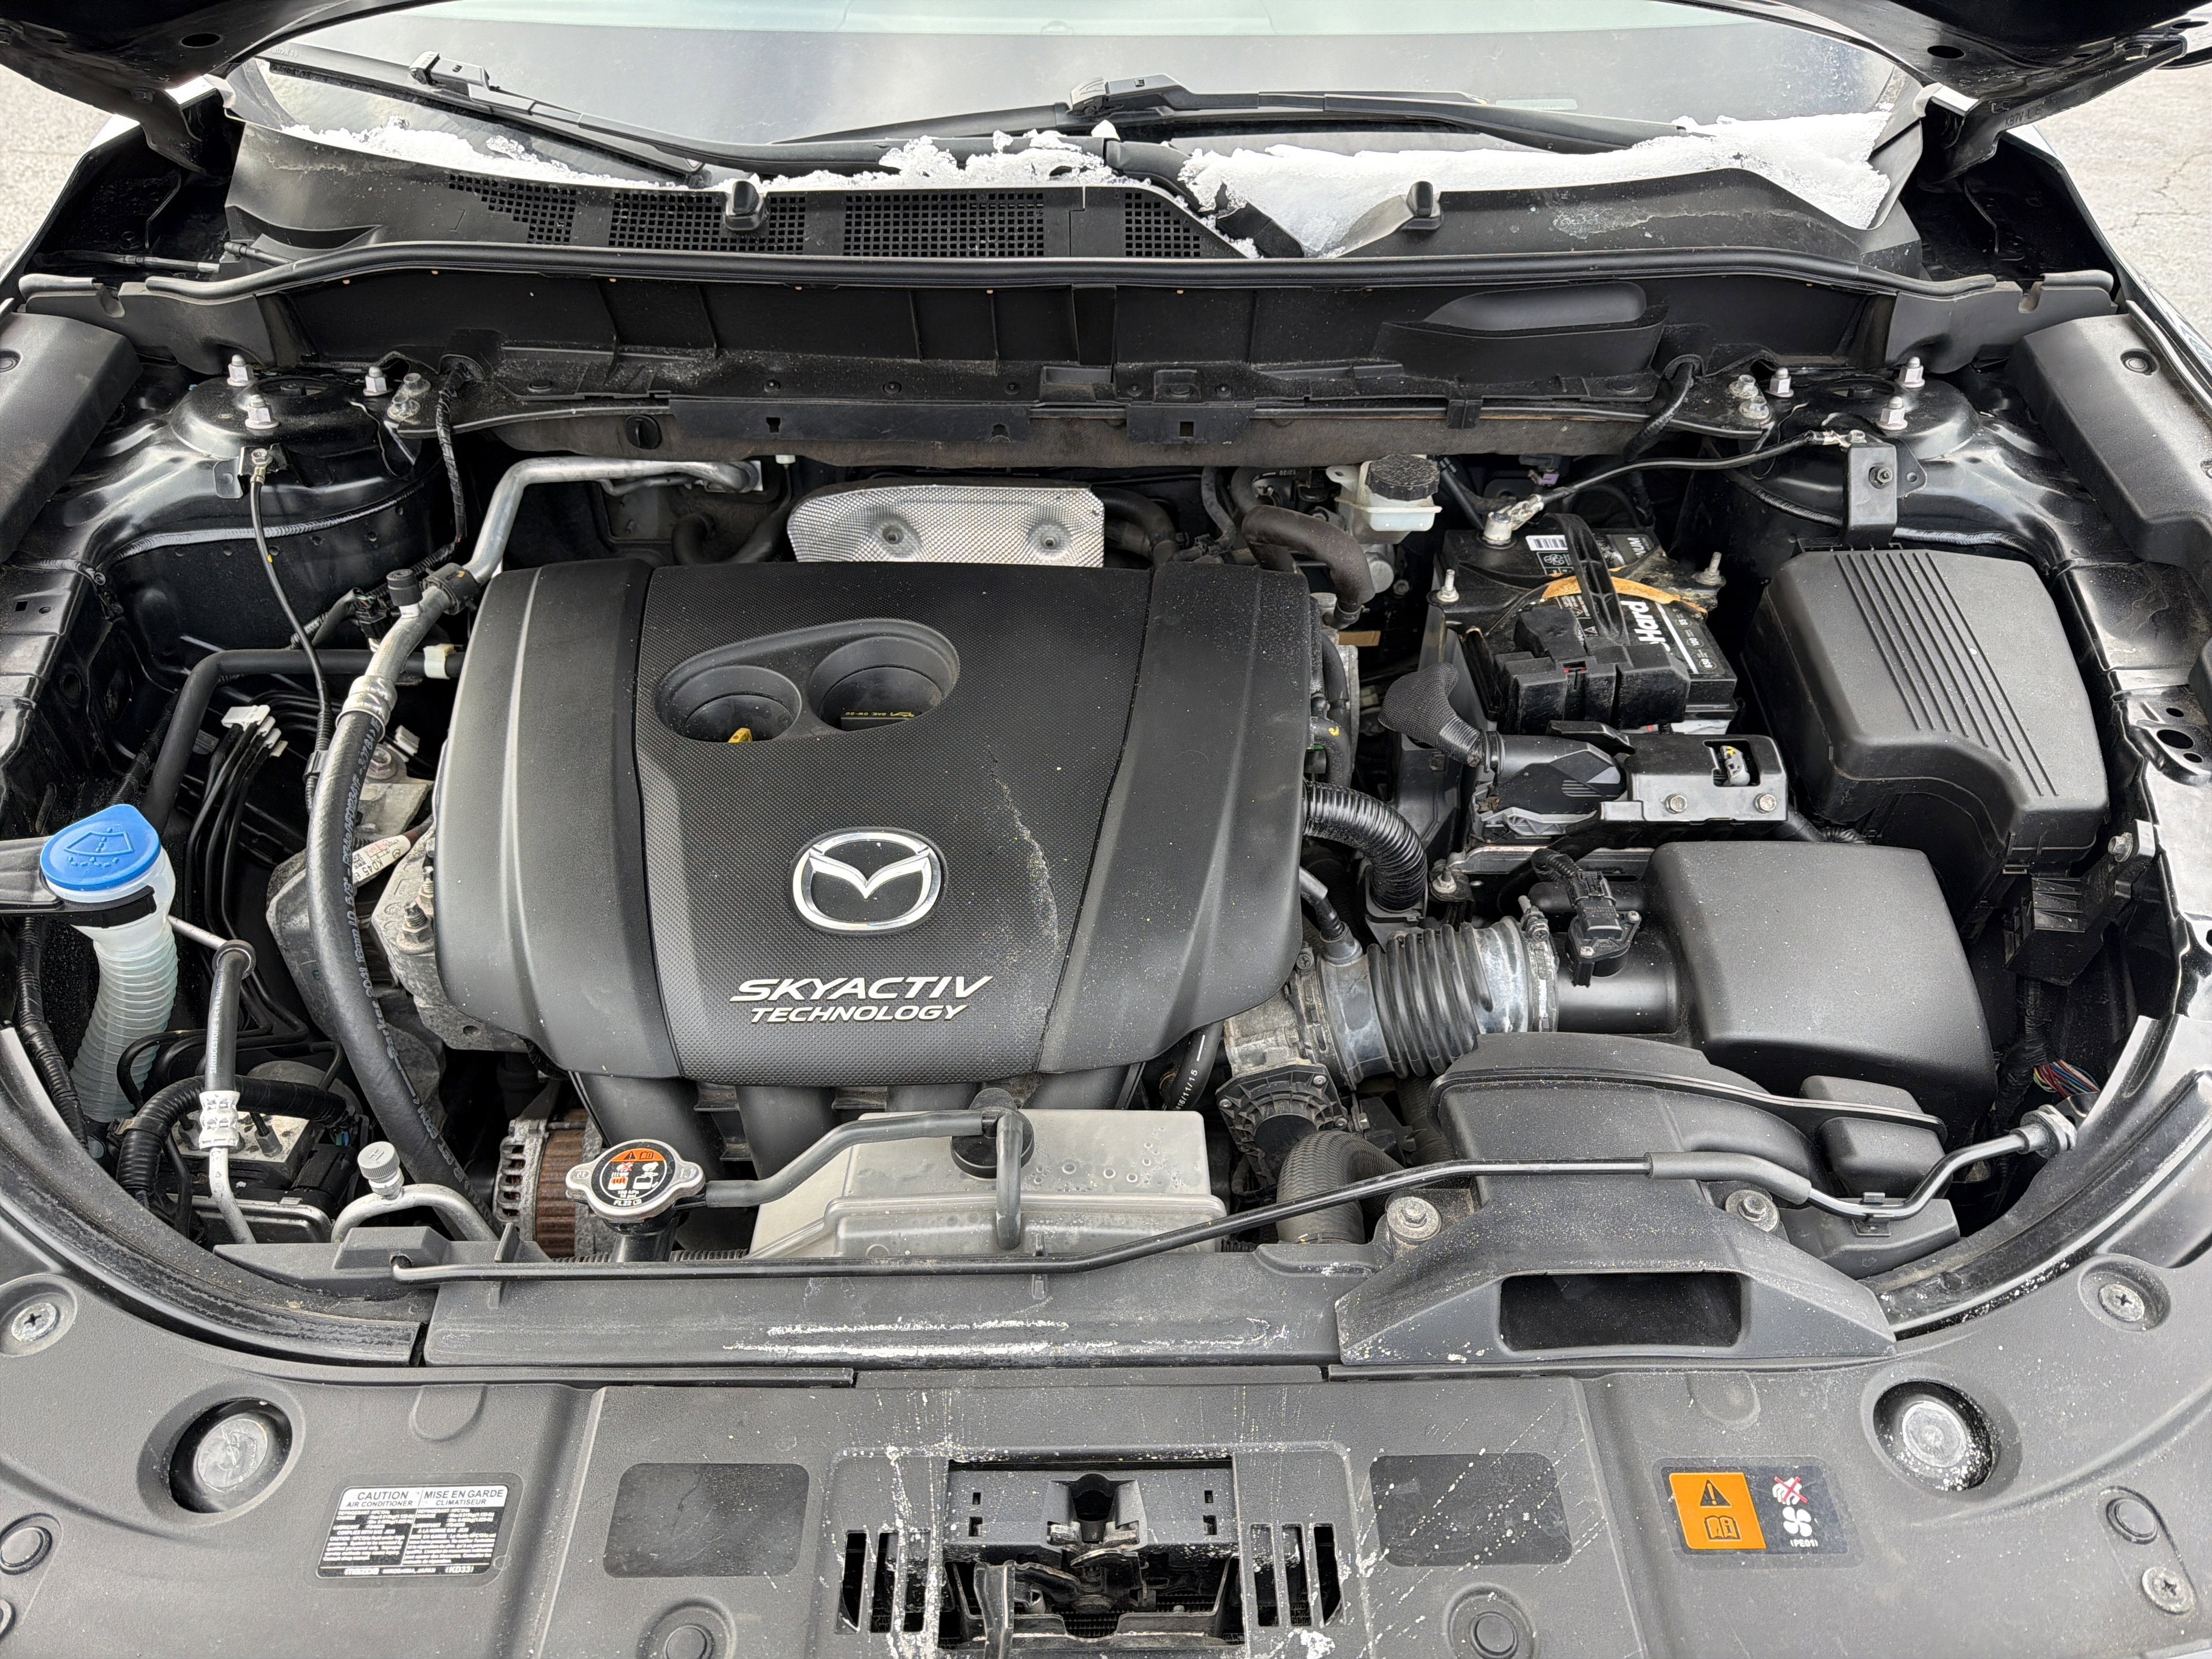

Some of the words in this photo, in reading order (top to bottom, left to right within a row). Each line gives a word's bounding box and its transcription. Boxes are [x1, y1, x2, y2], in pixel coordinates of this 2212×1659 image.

[1618, 600, 1673, 655] Hard
[1689, 637, 1700, 647] 100
[363, 859, 384, 877] KD45
[730, 976, 994, 1002] SKYACTIV
[750, 1005, 970, 1023] TECHNOLOGY
[210, 1024, 219, 1074] BRIDGESTONE
[358, 1491, 409, 1500] CAUTION
[424, 1491, 449, 1499] MISE
[452, 1490, 466, 1498] EN
[467, 1489, 504, 1498] GARDE
